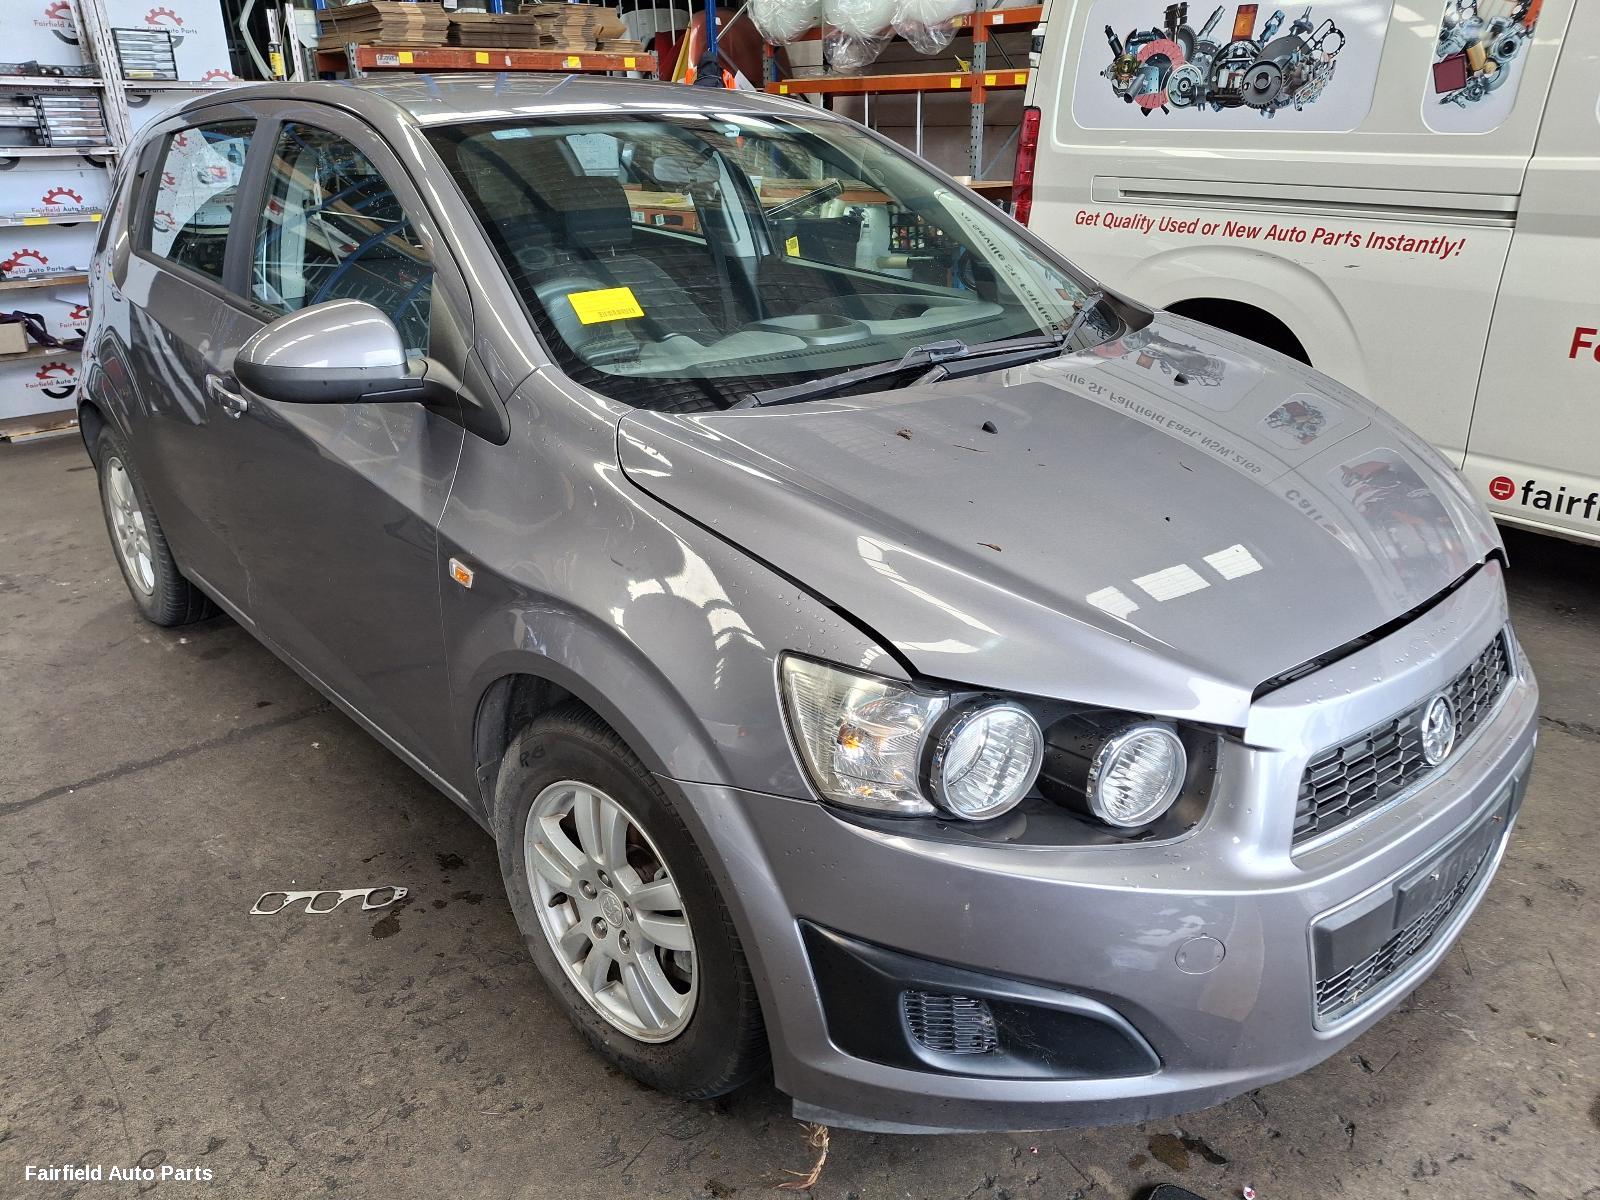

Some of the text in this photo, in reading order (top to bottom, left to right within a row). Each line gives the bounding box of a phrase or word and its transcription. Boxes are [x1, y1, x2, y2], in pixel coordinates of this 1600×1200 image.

[33, 19, 65, 28] Fairfield
[31, 205, 61, 213] Fairfield
[80, 204, 99, 212] Parts
[1074, 210, 1467, 260] Get Quality Used or New Auto Parts Instantly!
[25, 380, 54, 389] Fairfield
